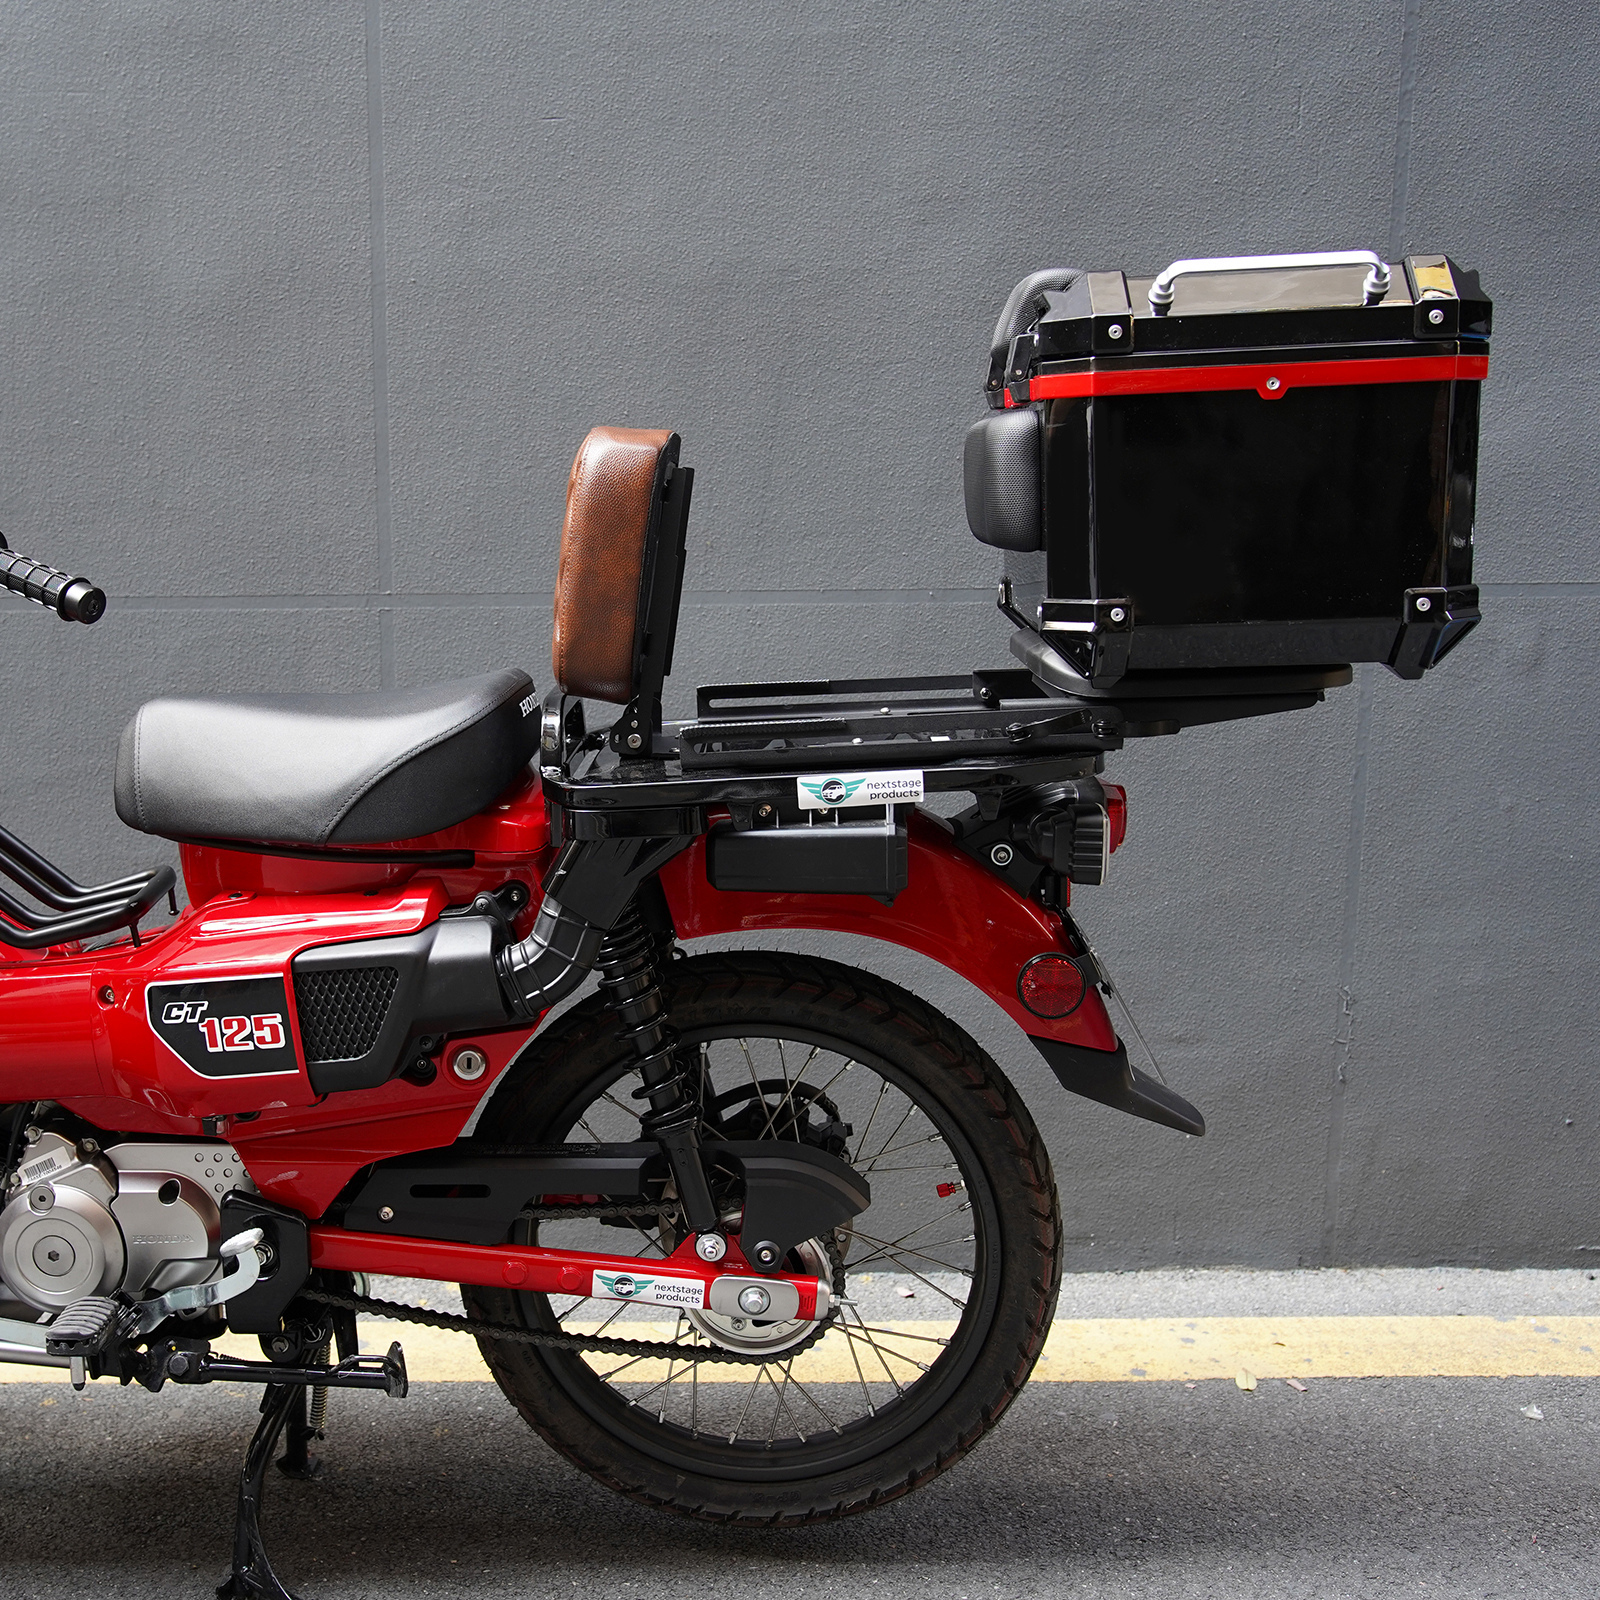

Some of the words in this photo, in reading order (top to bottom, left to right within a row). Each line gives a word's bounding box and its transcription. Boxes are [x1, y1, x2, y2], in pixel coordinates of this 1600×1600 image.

[867, 779, 922, 790] nextstage
[869, 790, 920, 800] products
[161, 1001, 209, 1024] CT
[198, 1013, 286, 1053] 125
[132, 1234, 194, 1245] HONDA
[654, 1284, 703, 1295] nextstage
[655, 1293, 701, 1304] products
